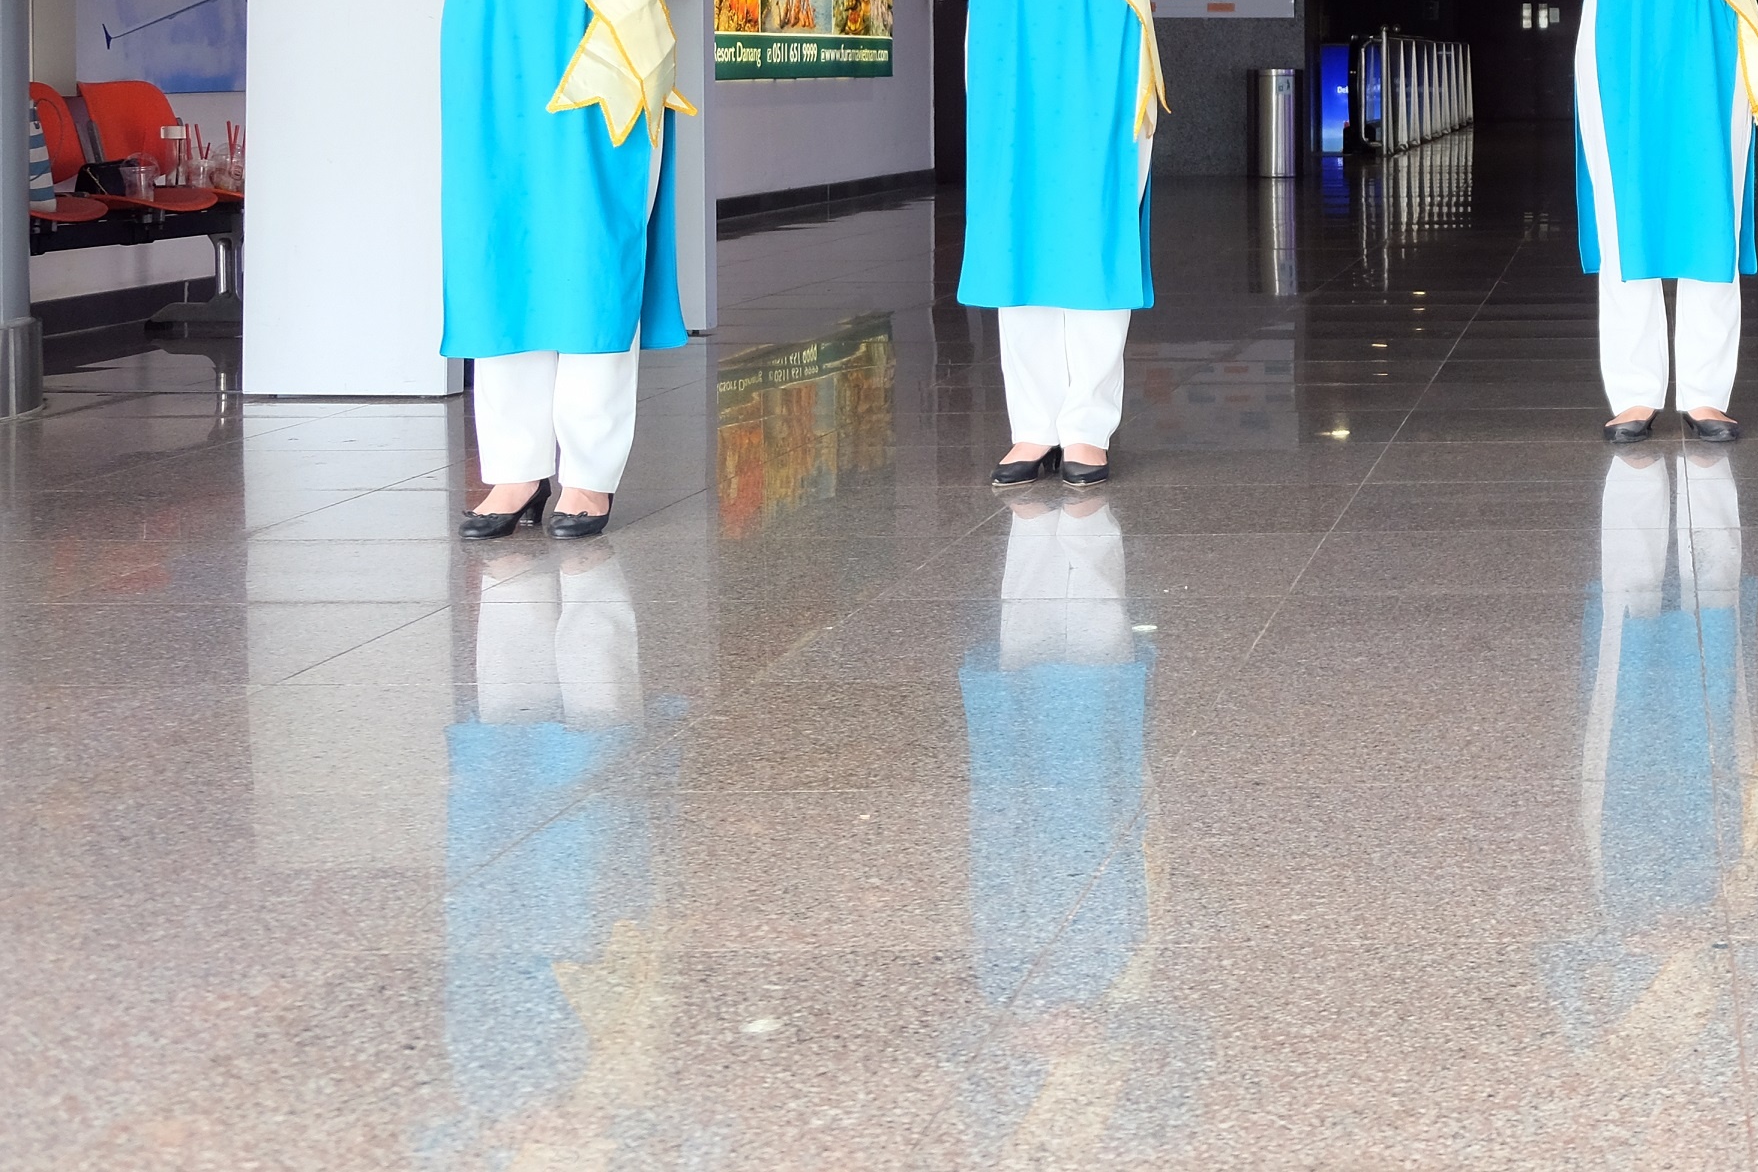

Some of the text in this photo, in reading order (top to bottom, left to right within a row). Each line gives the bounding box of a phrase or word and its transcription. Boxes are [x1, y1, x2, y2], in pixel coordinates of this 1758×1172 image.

[736, 41, 761, 68] Danang
[772, 42, 788, 63] 0511
[789, 42, 801, 63] 651
[802, 42, 818, 63] 9999
